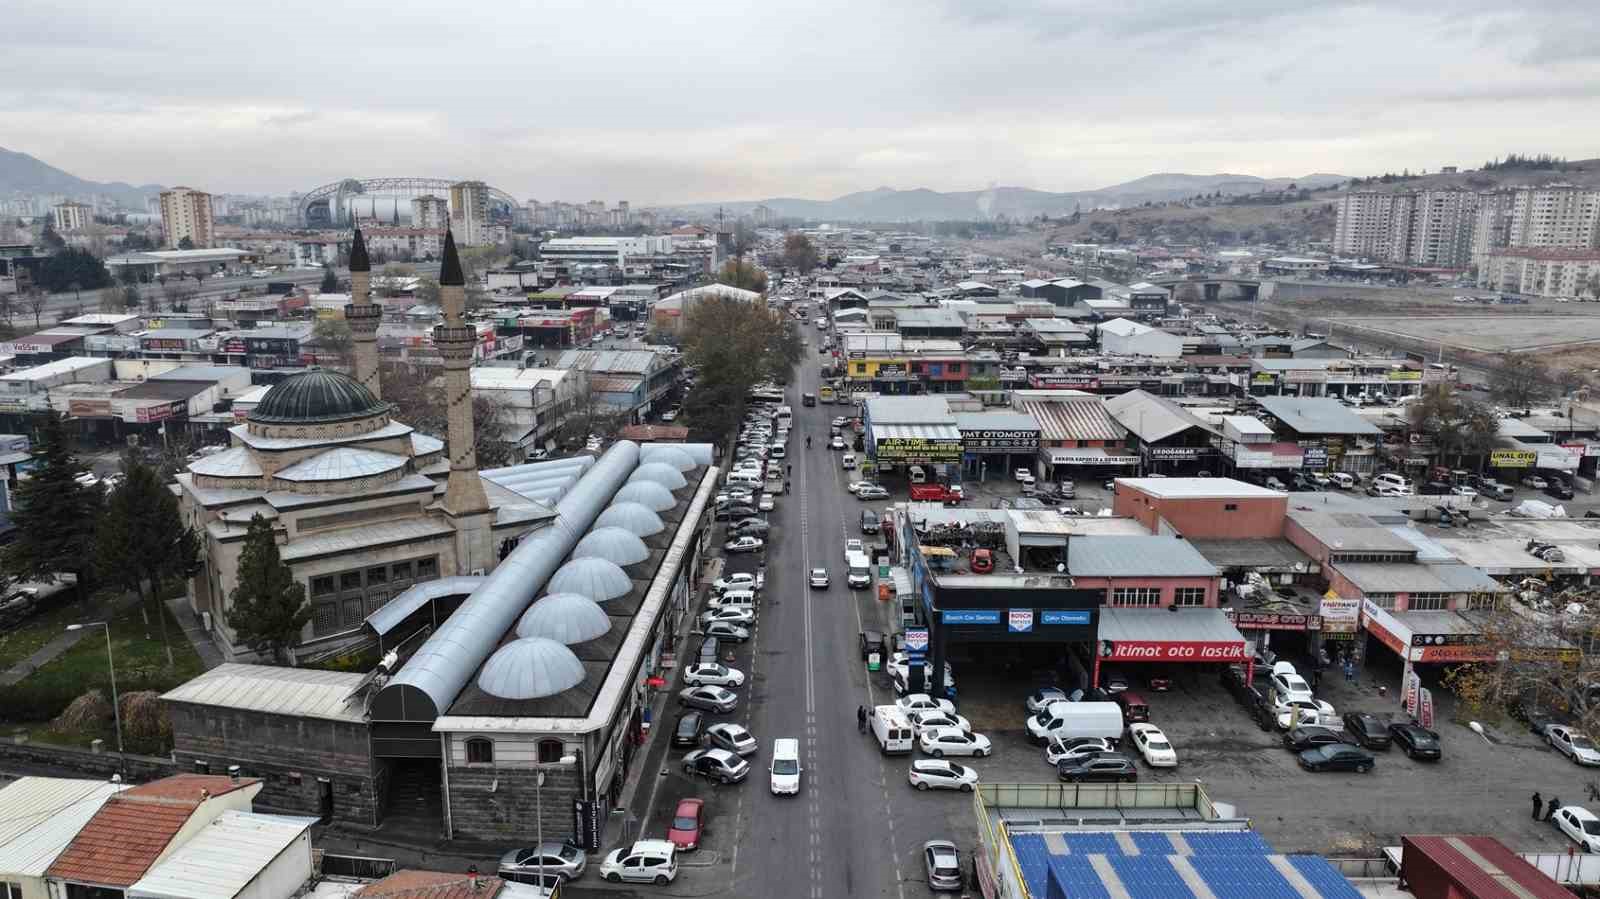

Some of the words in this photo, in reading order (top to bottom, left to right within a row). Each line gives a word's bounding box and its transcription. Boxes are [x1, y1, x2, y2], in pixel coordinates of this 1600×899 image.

[945, 613, 962, 621] Bosch
[965, 613, 973, 621] Car
[1115, 644, 1162, 657] itimat
[1167, 644, 1195, 657] oto
[1200, 644, 1242, 657] lastik
